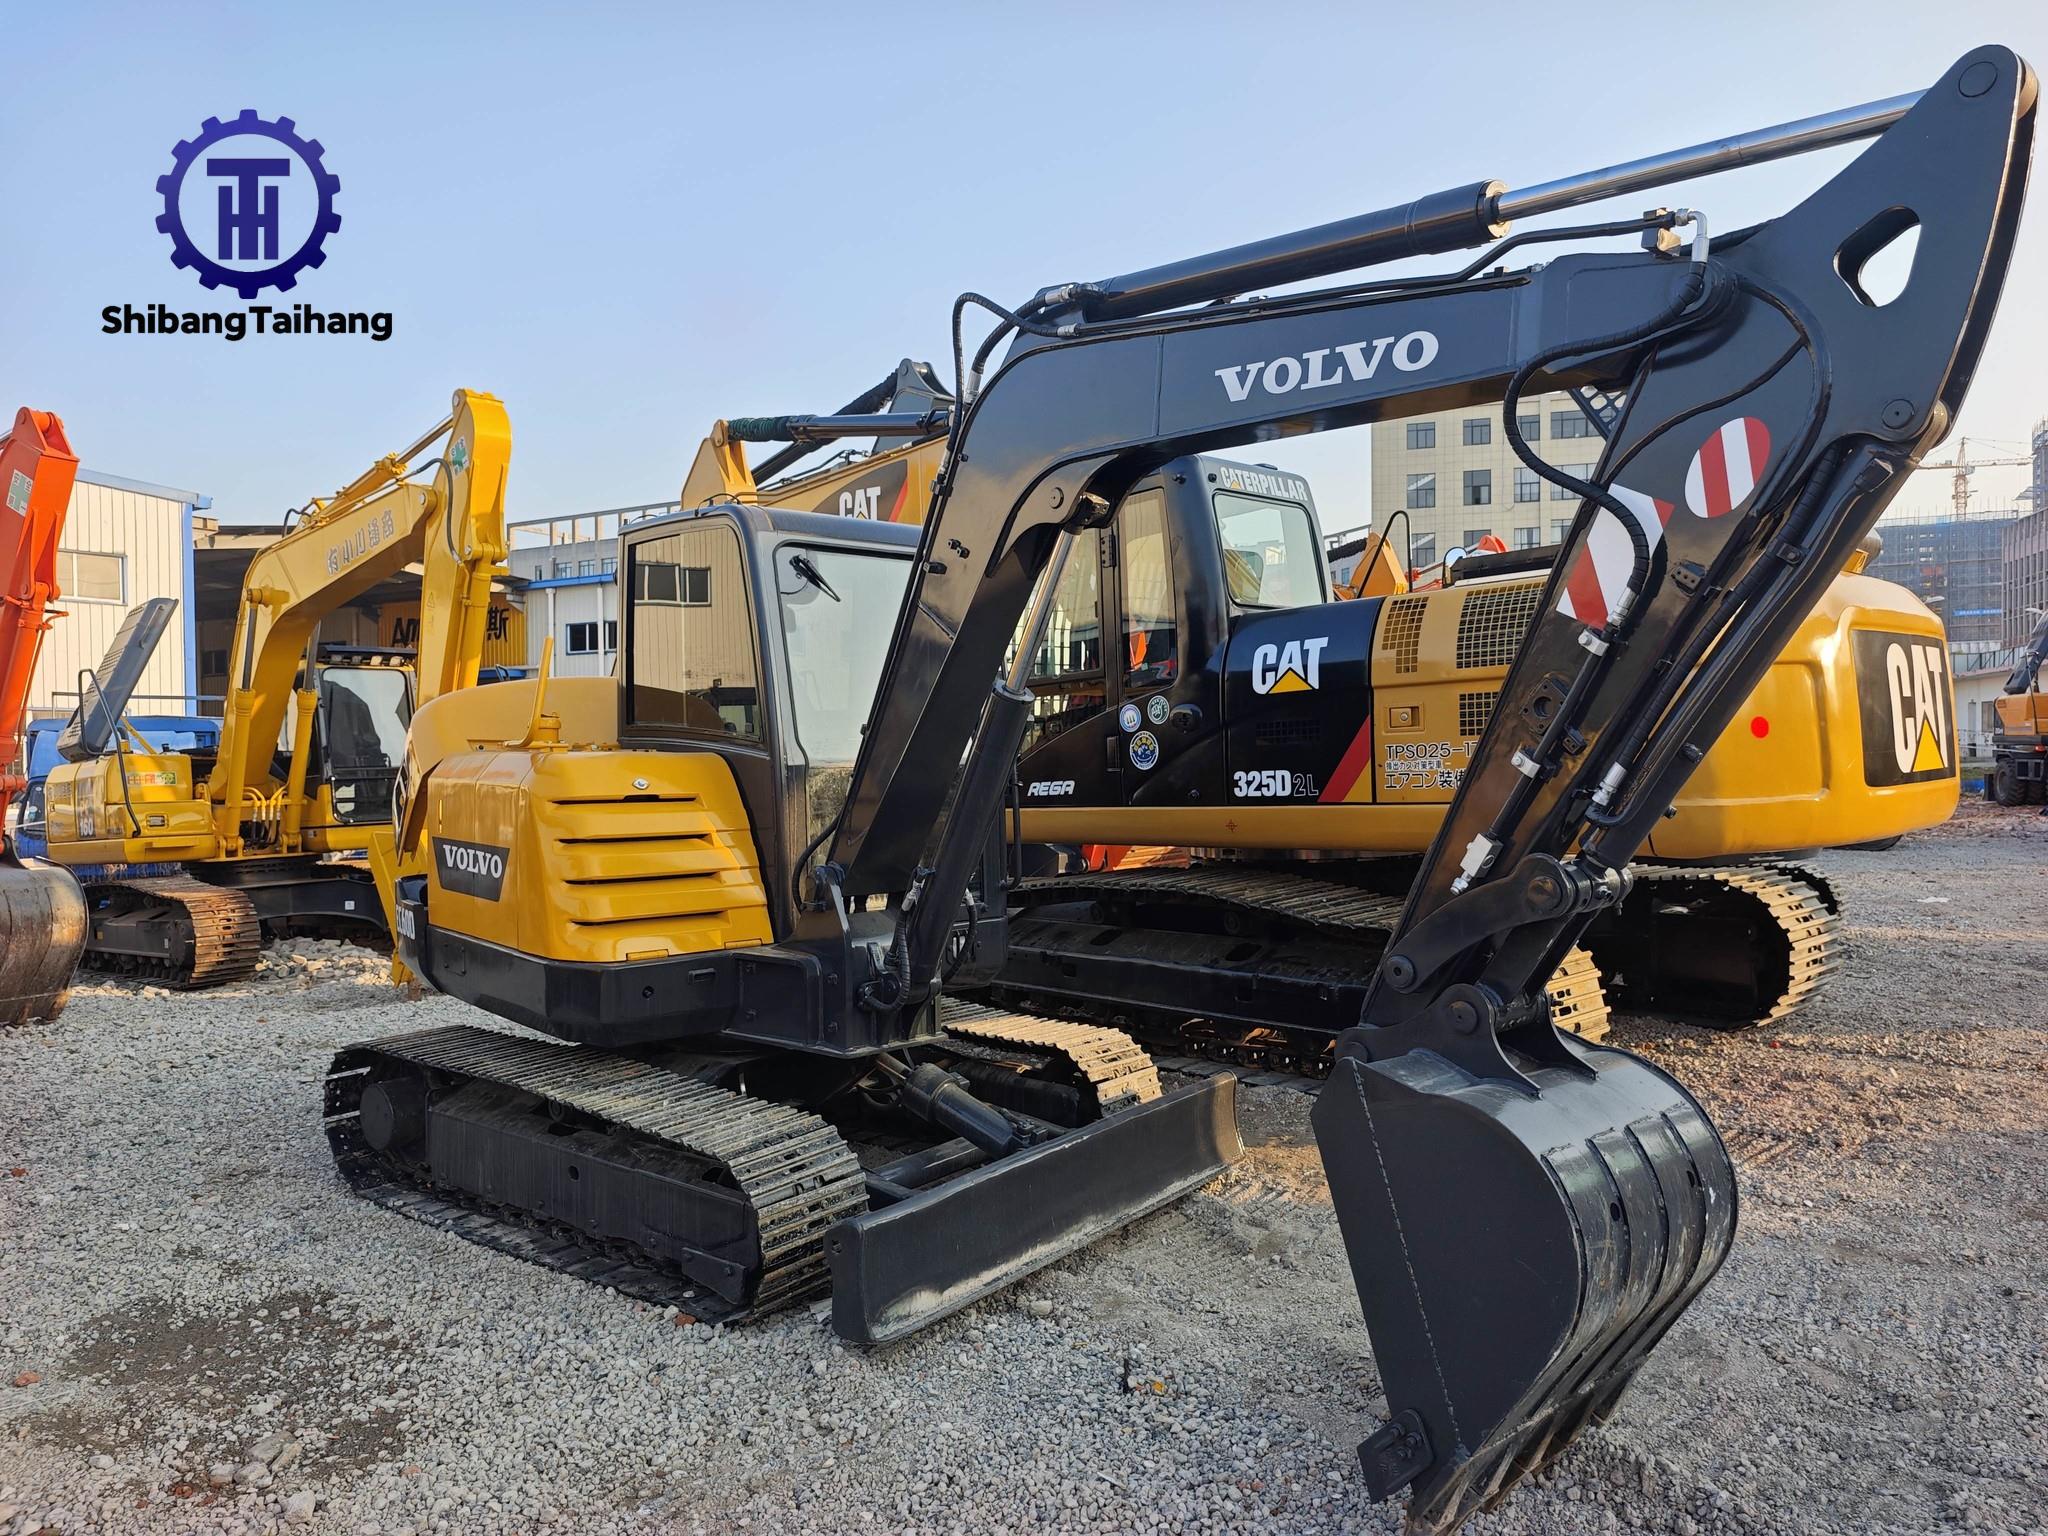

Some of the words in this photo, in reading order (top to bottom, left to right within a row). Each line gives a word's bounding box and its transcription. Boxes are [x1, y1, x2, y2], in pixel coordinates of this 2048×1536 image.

[1214, 330, 1439, 402] VOLVO
[1220, 467, 1309, 501] CATERPILLAR
[839, 486, 880, 520] CAT
[1252, 636, 1329, 695] CAT
[1886, 642, 1949, 773] CAT
[1027, 780, 1075, 797] REGA
[442, 844, 503, 879] VOLVO
